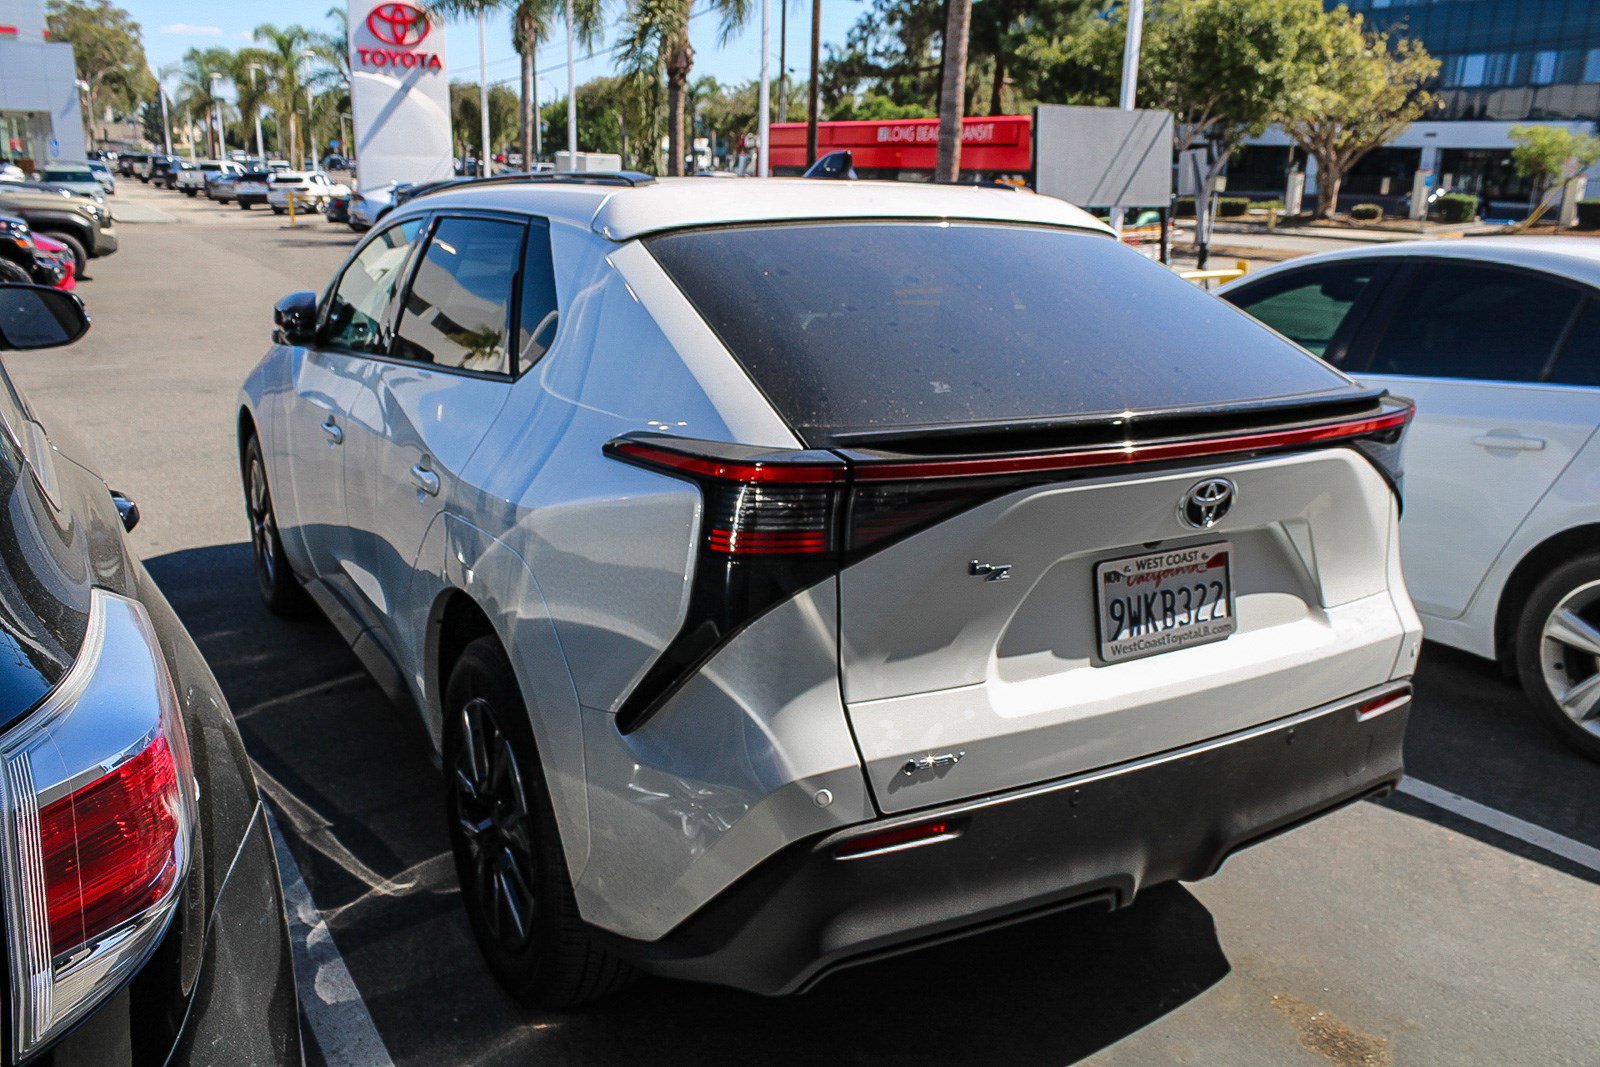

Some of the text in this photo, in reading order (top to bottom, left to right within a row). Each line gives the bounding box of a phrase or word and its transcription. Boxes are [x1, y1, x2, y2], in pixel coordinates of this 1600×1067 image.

[357, 47, 442, 70] TOYOTA
[888, 125, 915, 142] LONG
[1135, 550, 1200, 571] WEST COAST
[1109, 580, 1225, 643] 9WKB322
